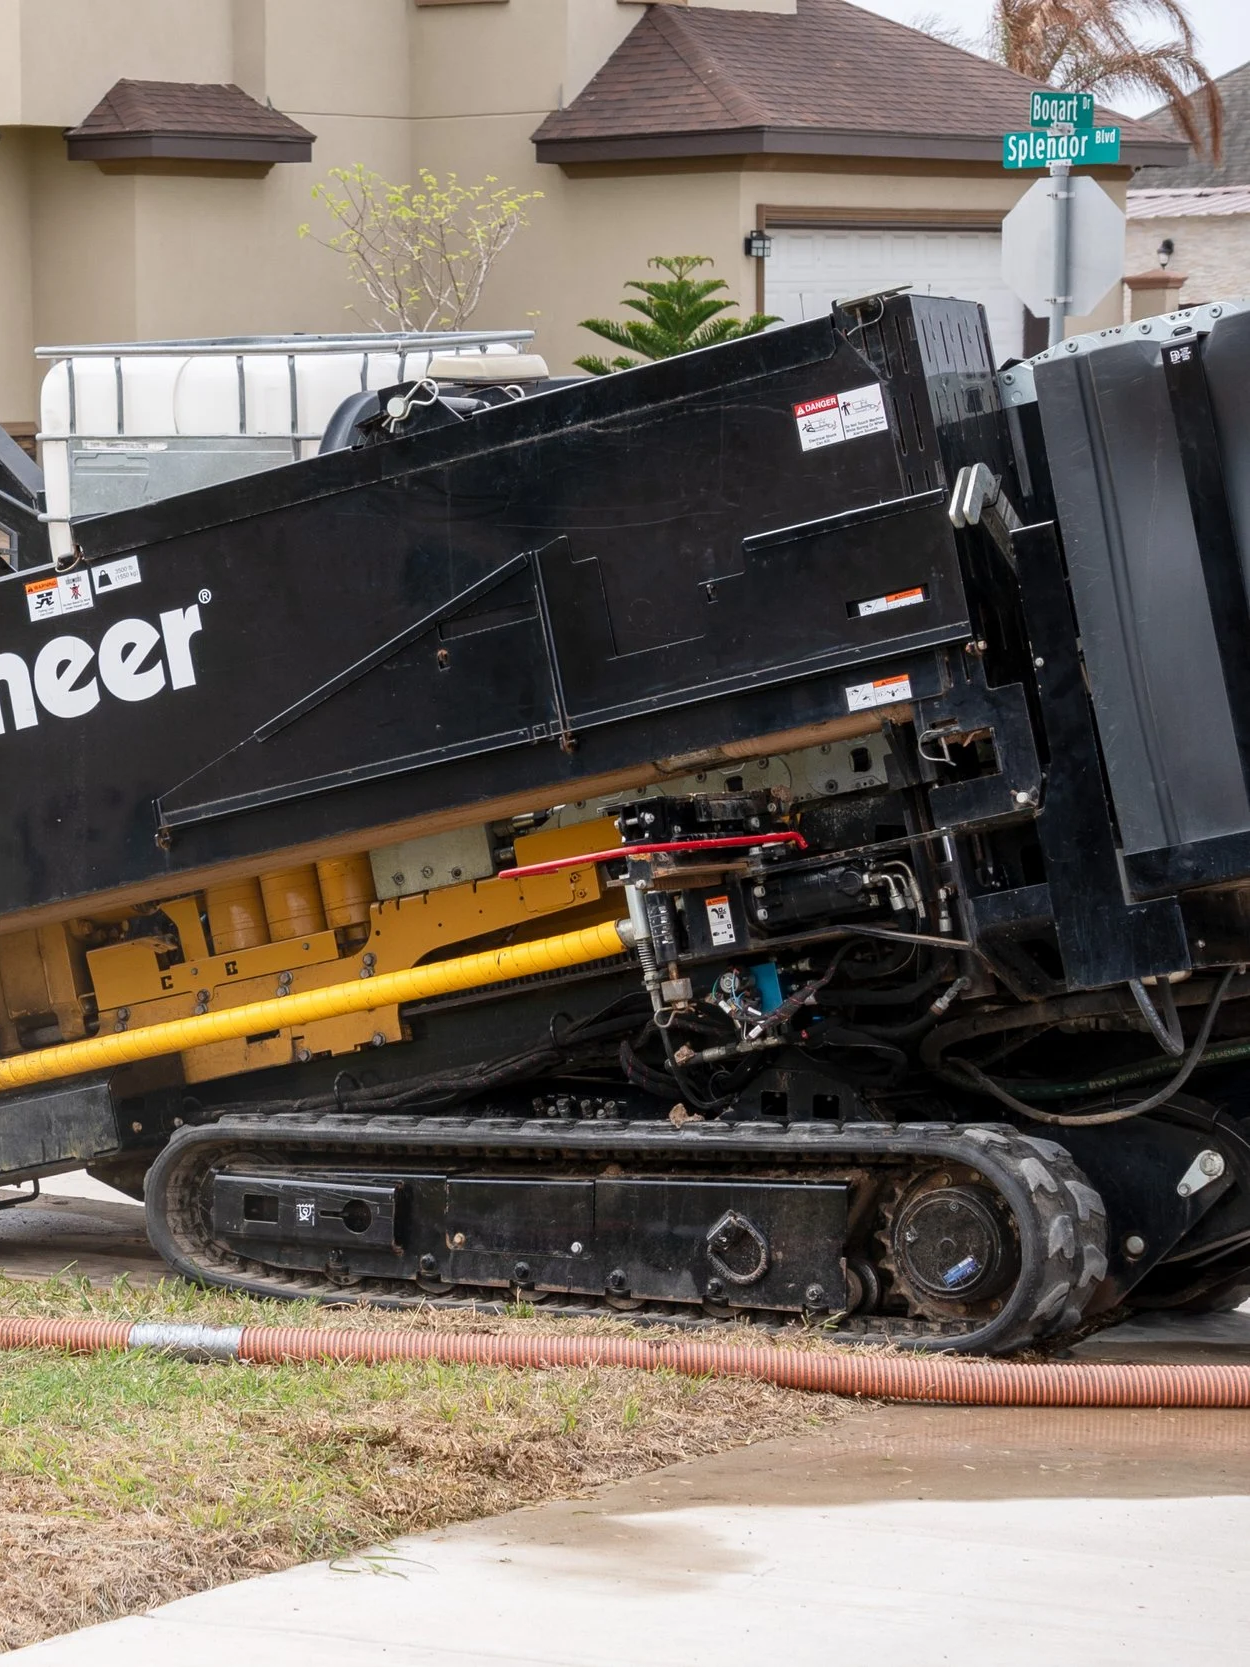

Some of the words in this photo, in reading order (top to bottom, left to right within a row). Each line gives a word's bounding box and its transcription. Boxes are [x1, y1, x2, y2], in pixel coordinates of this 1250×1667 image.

[1033, 94, 1078, 123] Bogart
[1083, 96, 1091, 110] Dr
[1008, 132, 1088, 168] Splendor
[1095, 128, 1116, 144] Blvd
[805, 398, 837, 412] DANGER
